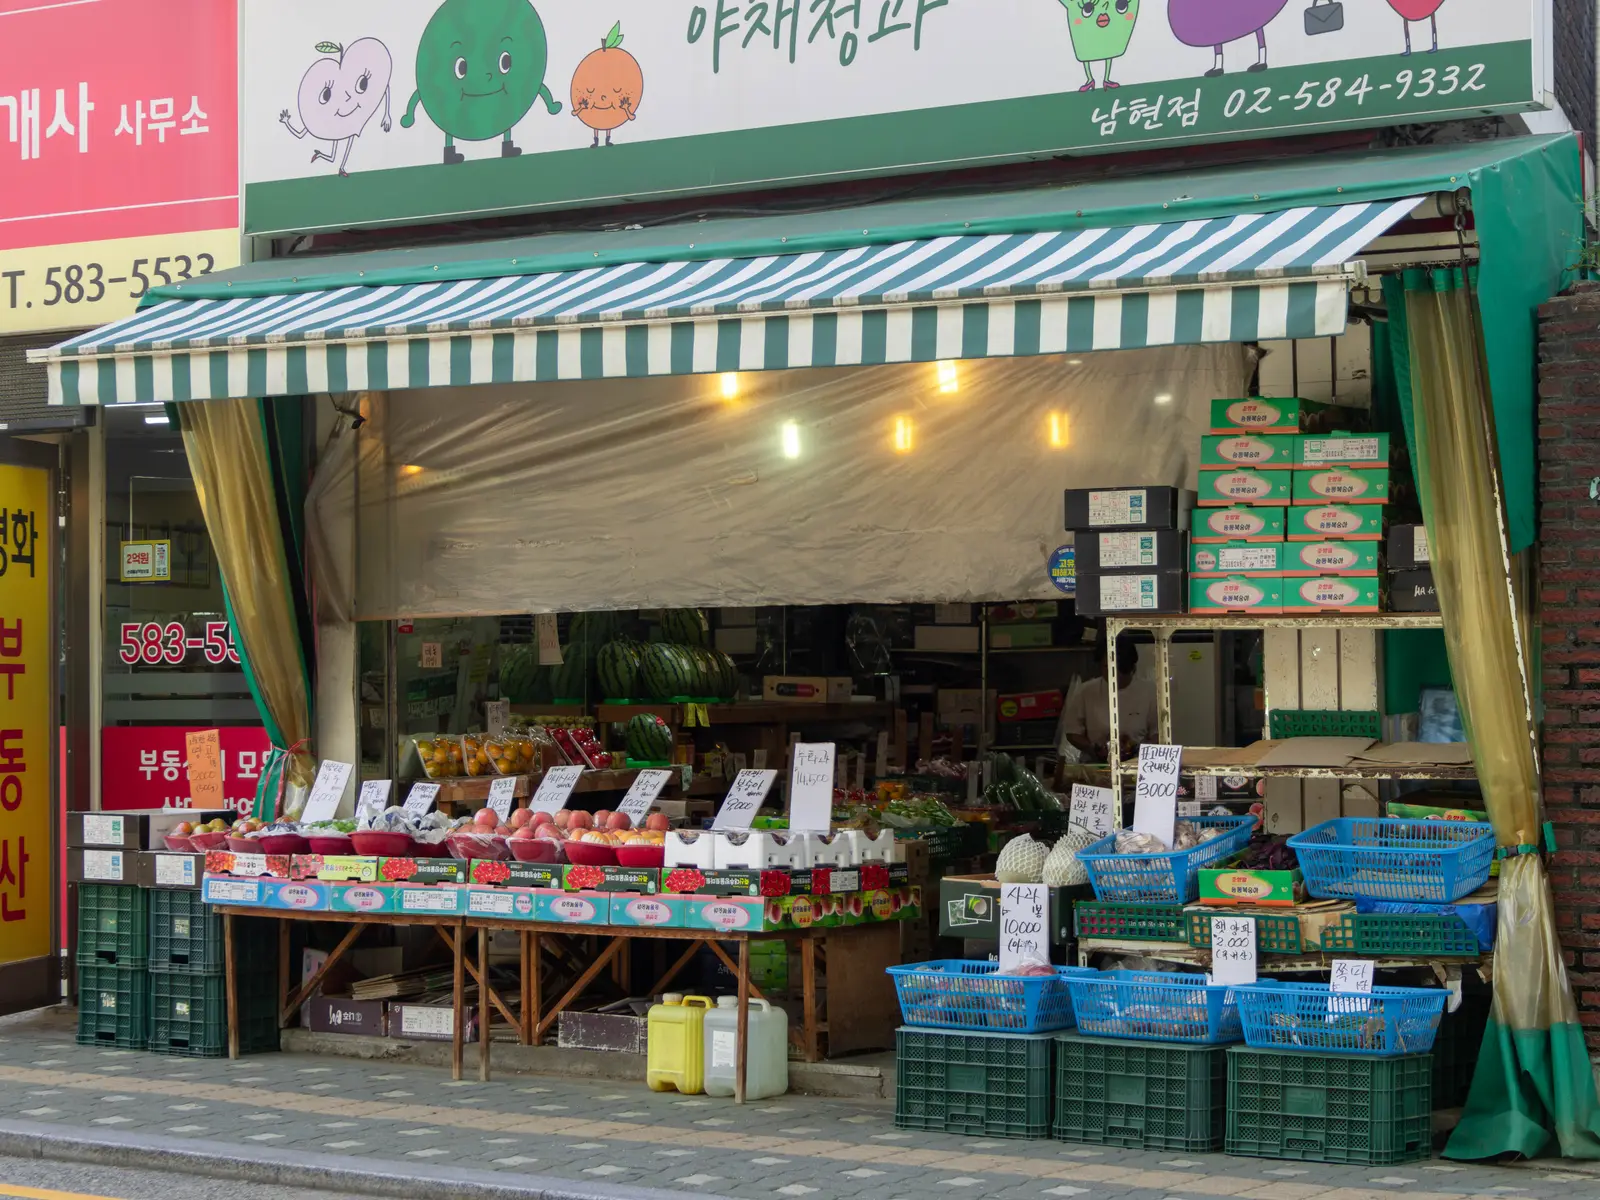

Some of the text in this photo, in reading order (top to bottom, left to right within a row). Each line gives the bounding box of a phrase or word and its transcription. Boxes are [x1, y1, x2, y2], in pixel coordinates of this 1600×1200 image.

[1091, 63, 1487, 136] 남현점 02-584-9332
[114, 95, 210, 146] 사무소
[2, 270, 33, 309] T.
[1141, 745, 1180, 763] 표고버섯
[1006, 886, 1041, 904] 사과
